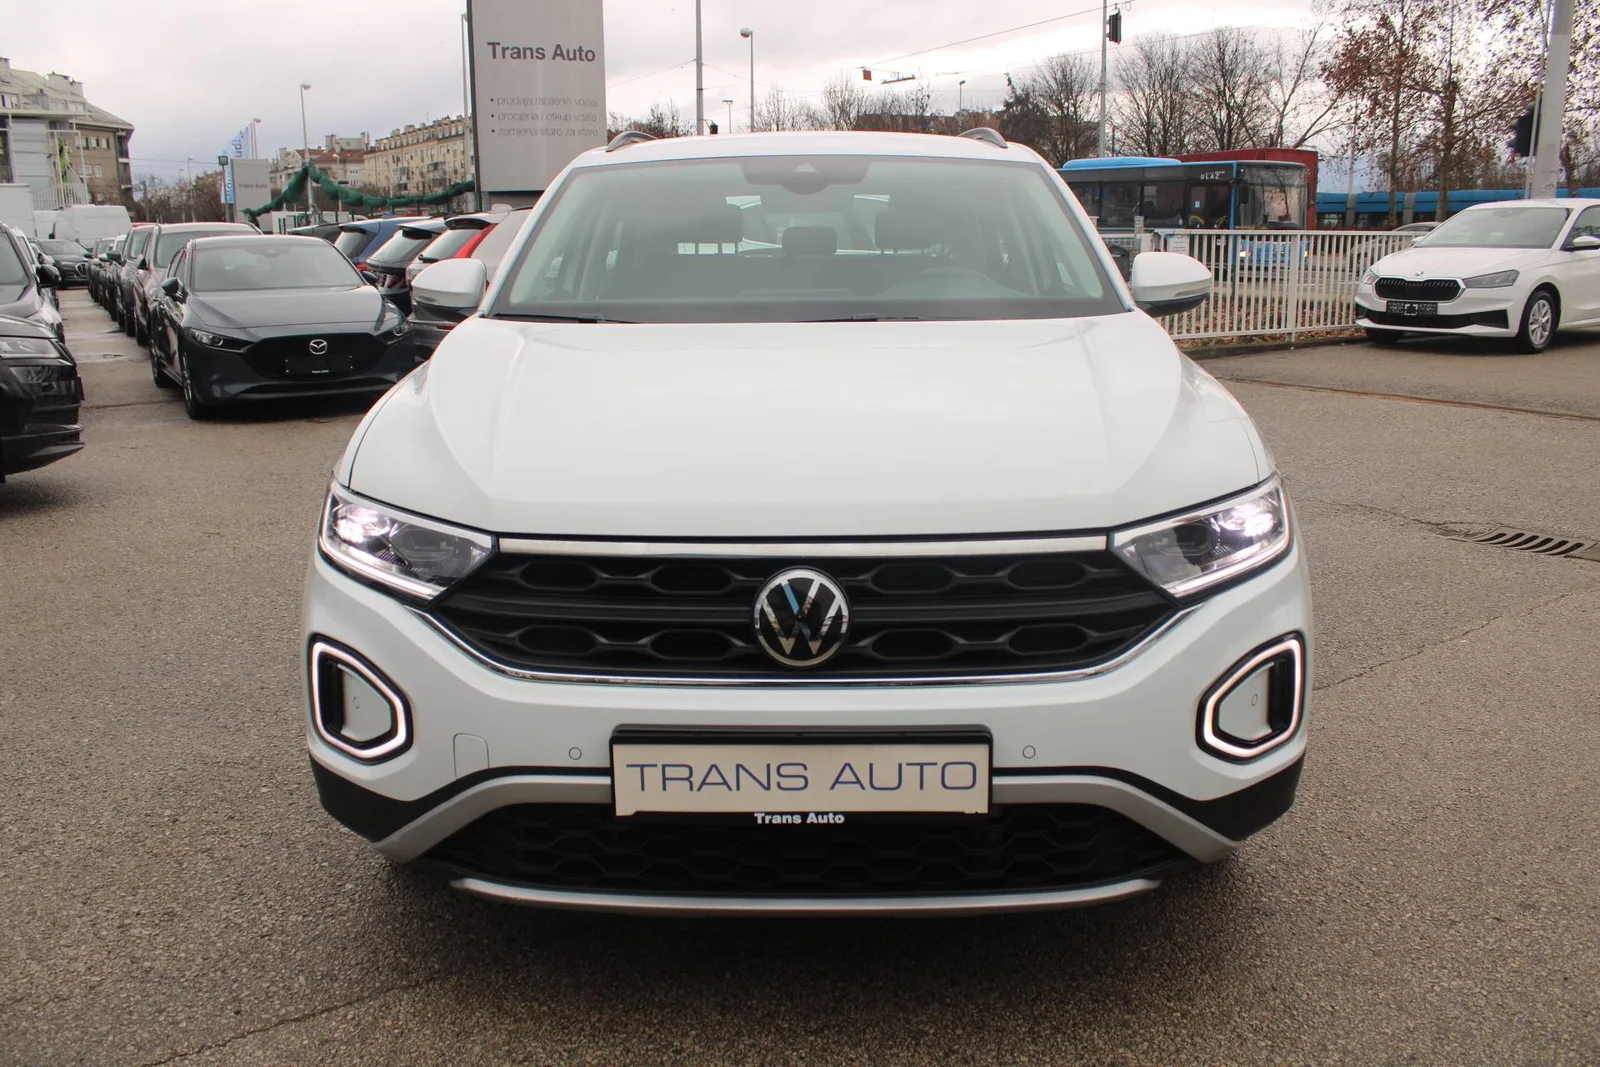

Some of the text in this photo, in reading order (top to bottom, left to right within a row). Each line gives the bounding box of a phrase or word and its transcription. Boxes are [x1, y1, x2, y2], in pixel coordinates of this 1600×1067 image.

[487, 41, 596, 62] Trans Auto
[497, 95, 533, 107] prodaja
[626, 761, 978, 792] TRANS AUTO
[754, 812, 845, 825] Trans Auto
